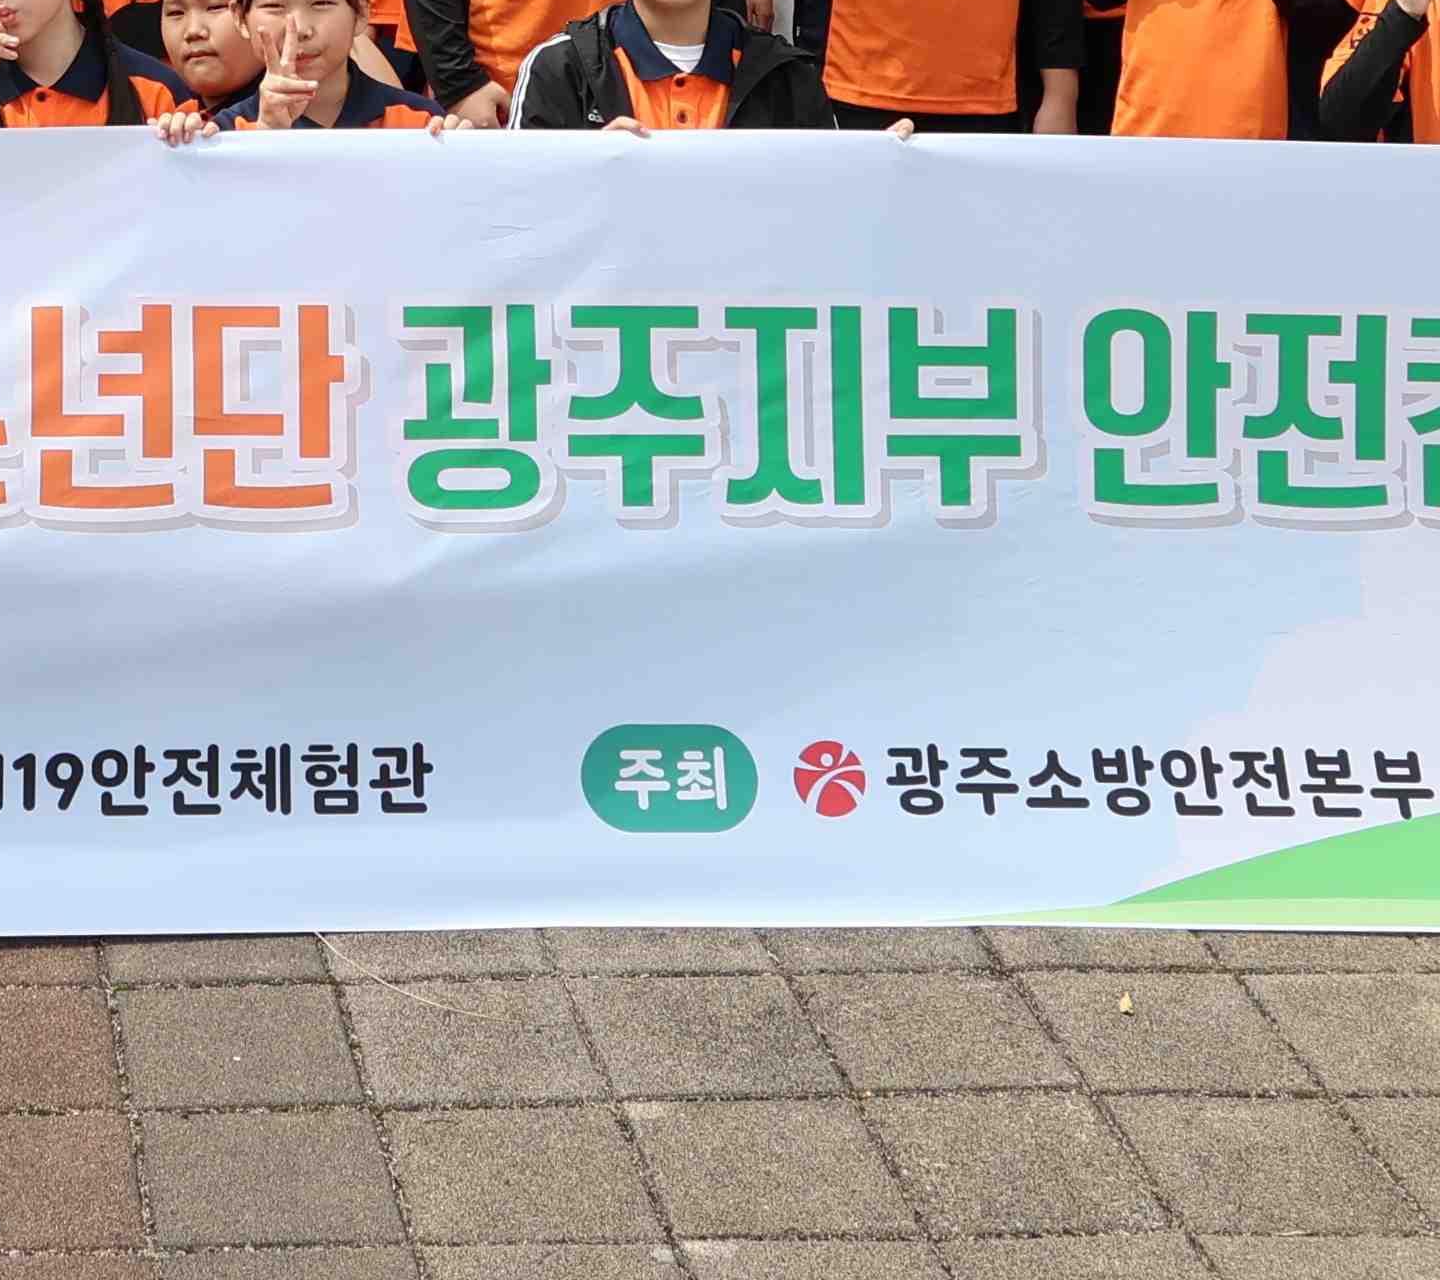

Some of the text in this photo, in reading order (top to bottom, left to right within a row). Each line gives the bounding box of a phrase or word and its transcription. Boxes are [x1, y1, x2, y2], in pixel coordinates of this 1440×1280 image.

[404, 304, 1022, 509] 광주지부
[614, 746, 727, 811] 주최
[885, 743, 1435, 820] 광주소방안전본부
